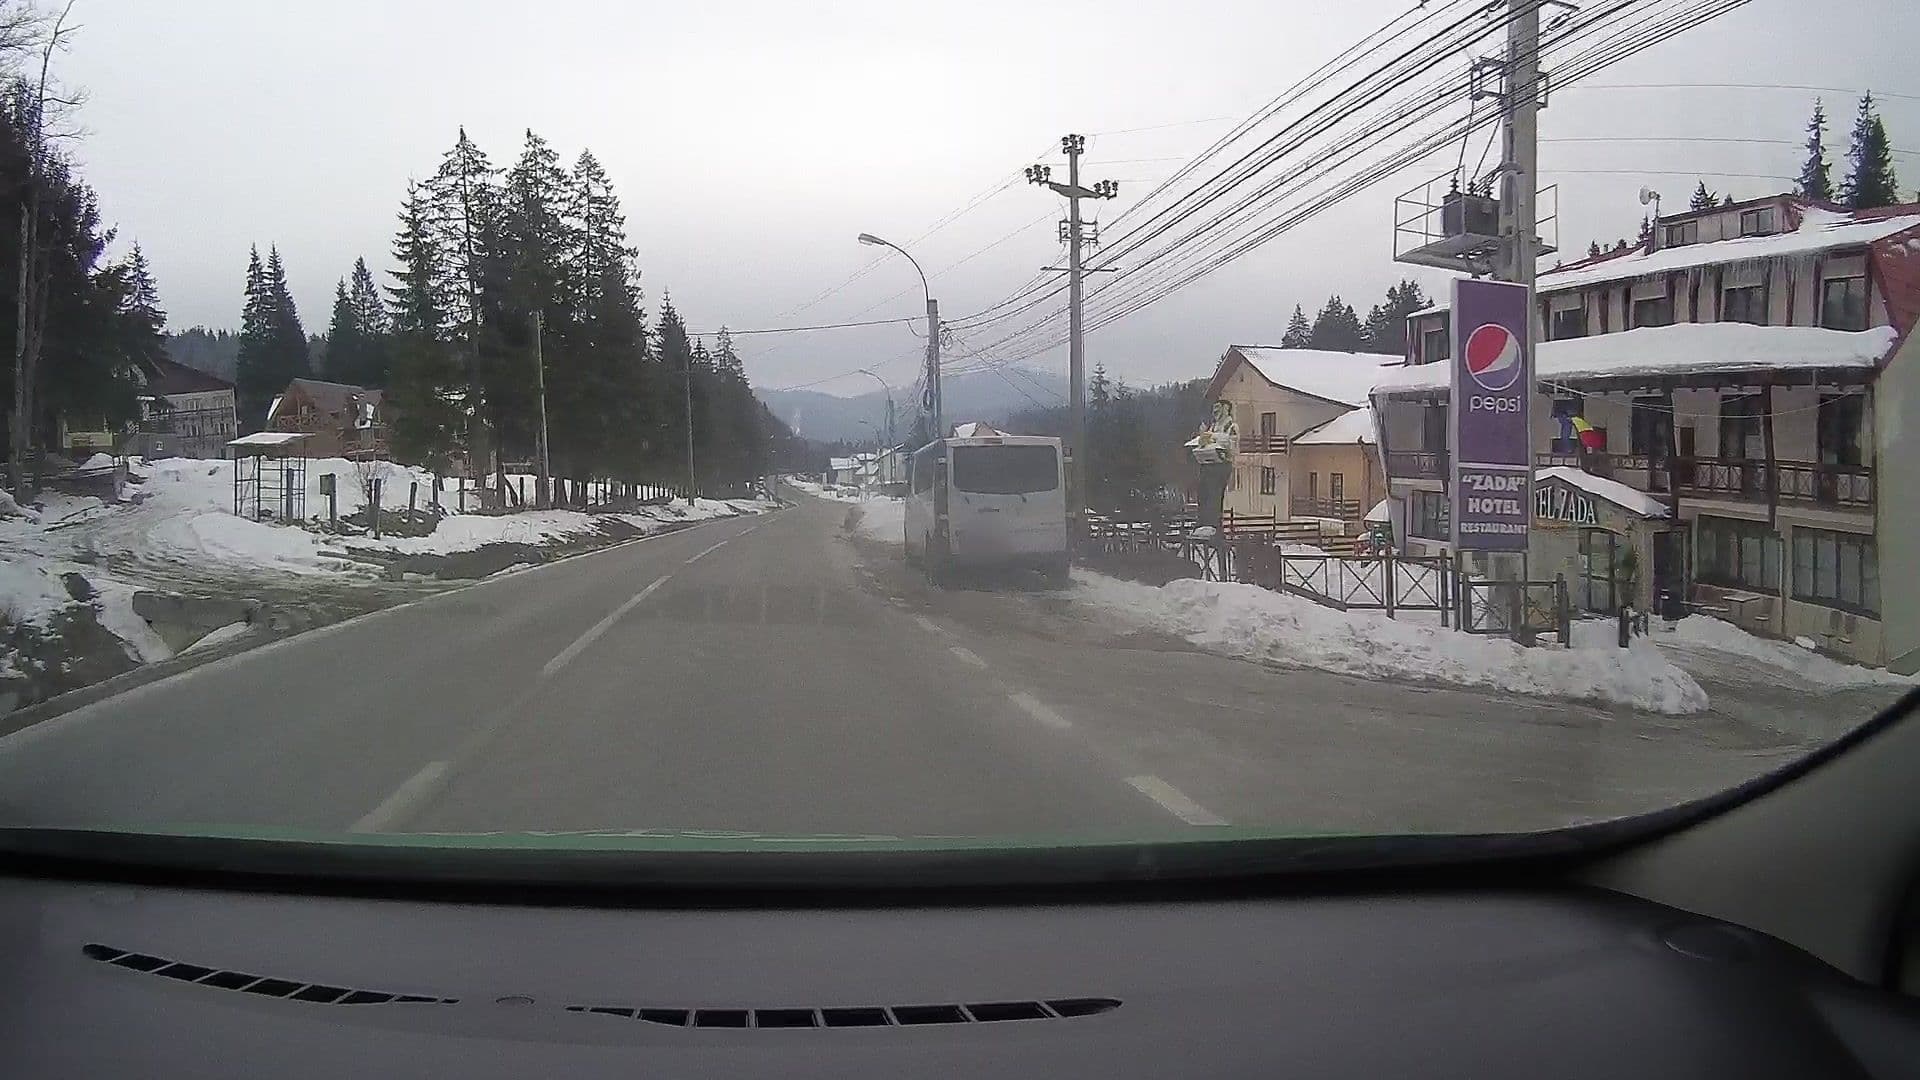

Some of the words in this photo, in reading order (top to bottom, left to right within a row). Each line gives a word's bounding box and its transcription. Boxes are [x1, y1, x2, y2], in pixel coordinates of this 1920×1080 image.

[1469, 395, 1521, 414] pepsi
[1468, 497, 1521, 515] HOTEL
[1559, 489, 1596, 524] ZADA
[1460, 522, 1528, 536] RESTAURANT
